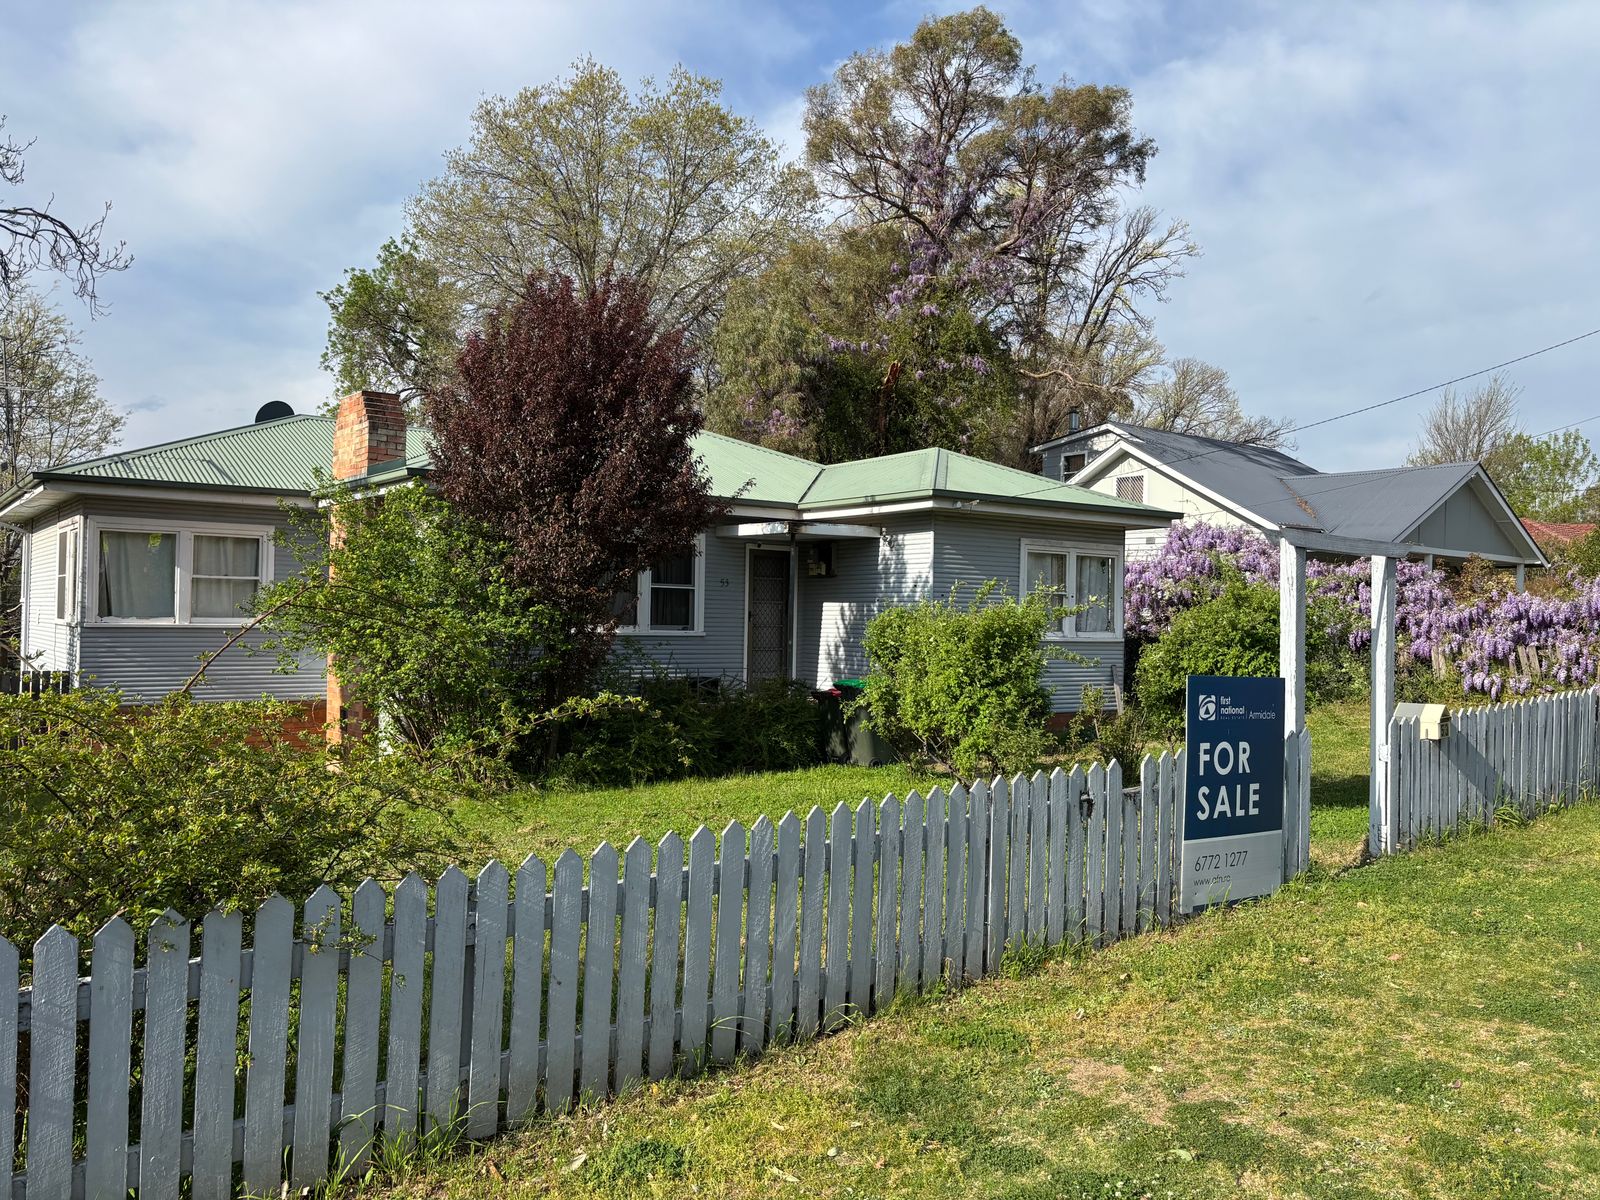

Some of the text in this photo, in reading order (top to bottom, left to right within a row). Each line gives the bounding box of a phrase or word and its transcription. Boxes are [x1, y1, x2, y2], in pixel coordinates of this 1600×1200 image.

[1220, 696, 1231, 705] first
[1220, 706, 1245, 715] national
[1248, 710, 1276, 719] Armidale
[1199, 741, 1251, 776] FOR
[1196, 783, 1260, 821] SALE
[1194, 851, 1248, 872] 6772 1277
